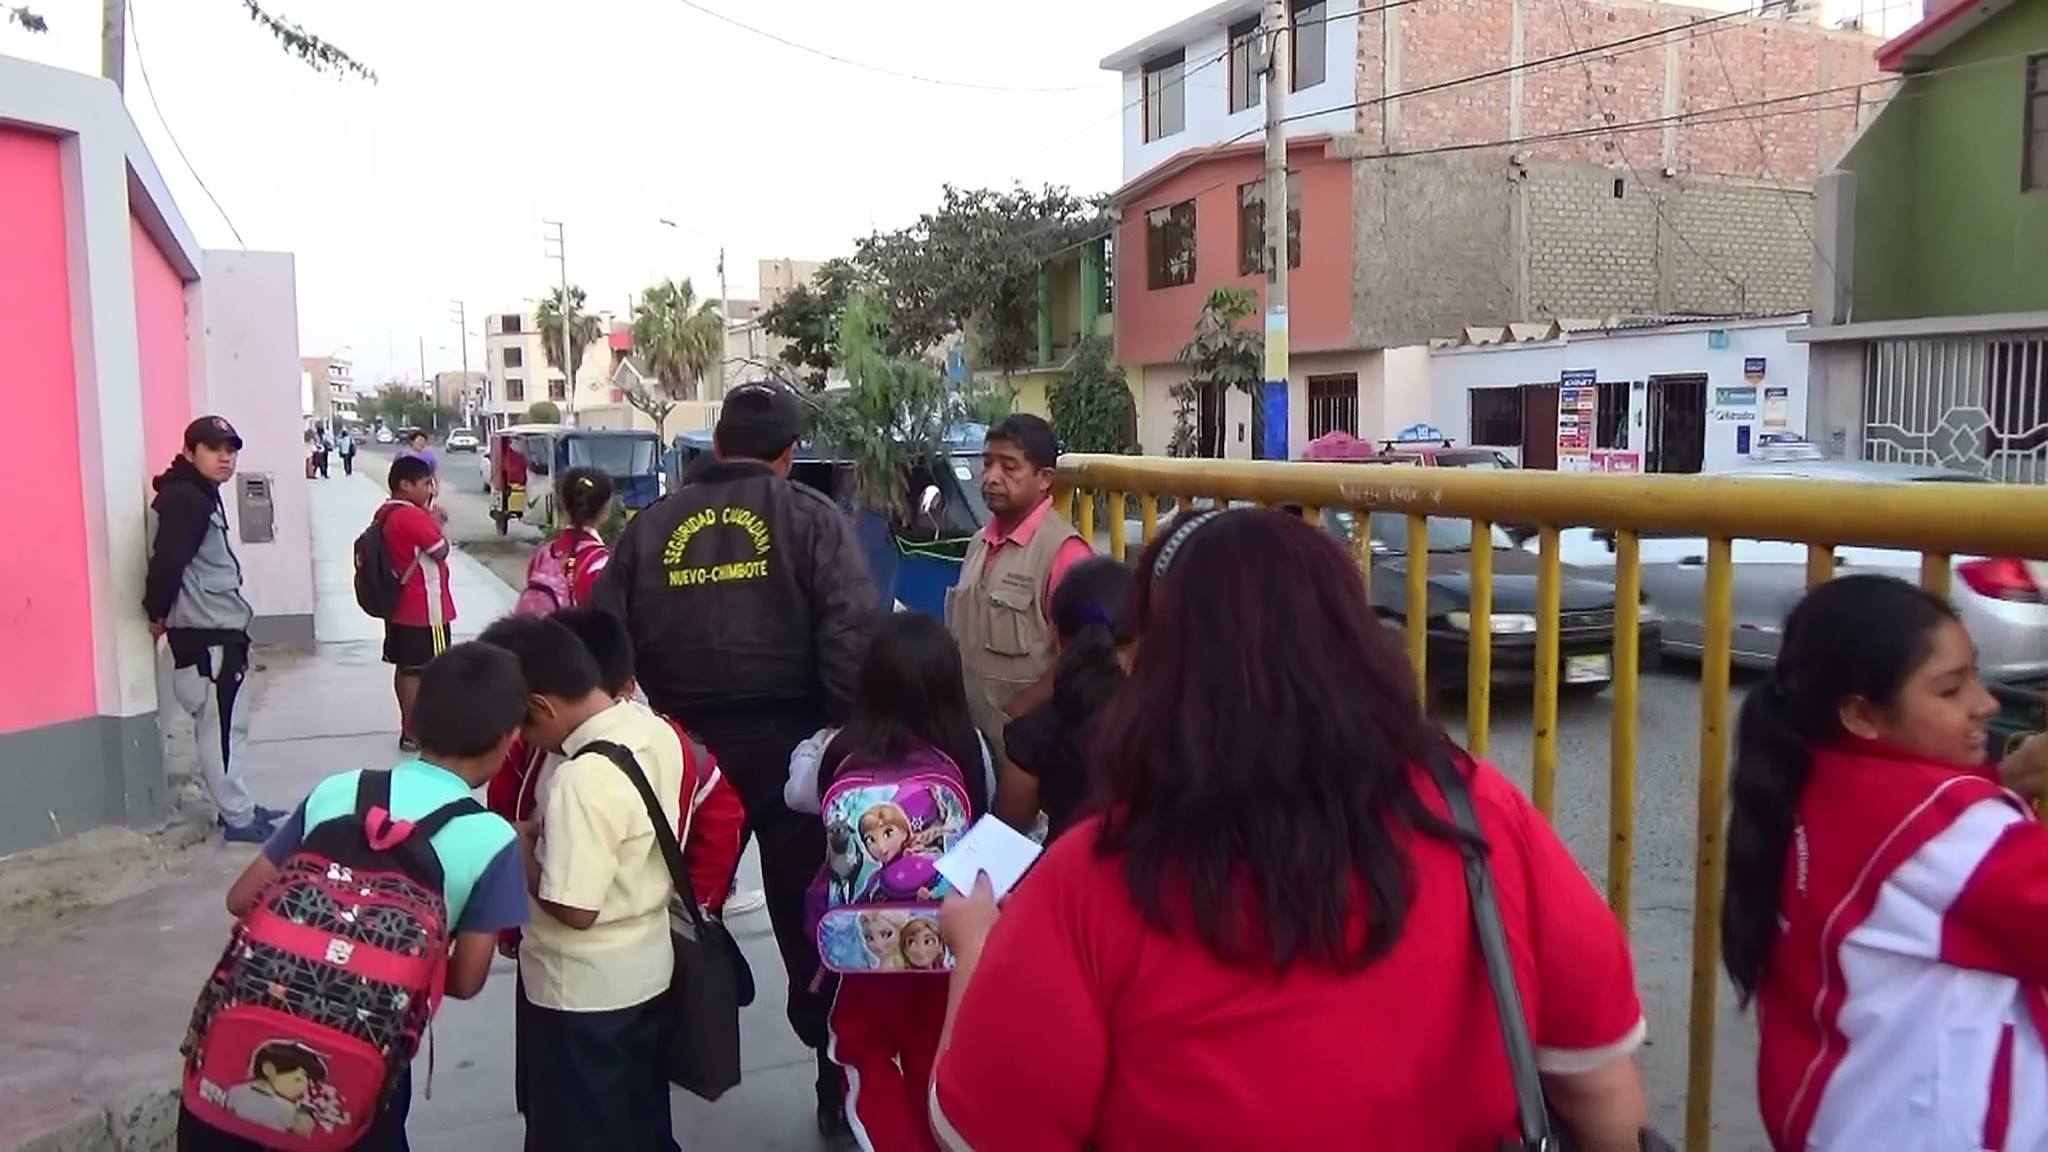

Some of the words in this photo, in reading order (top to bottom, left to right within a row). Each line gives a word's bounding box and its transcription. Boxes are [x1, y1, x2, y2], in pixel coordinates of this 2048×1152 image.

[663, 508, 716, 565] SEGURIDAD
[722, 507, 771, 555] CIUDADANA
[669, 560, 768, 586] NUEVO-CHIMBOTE
